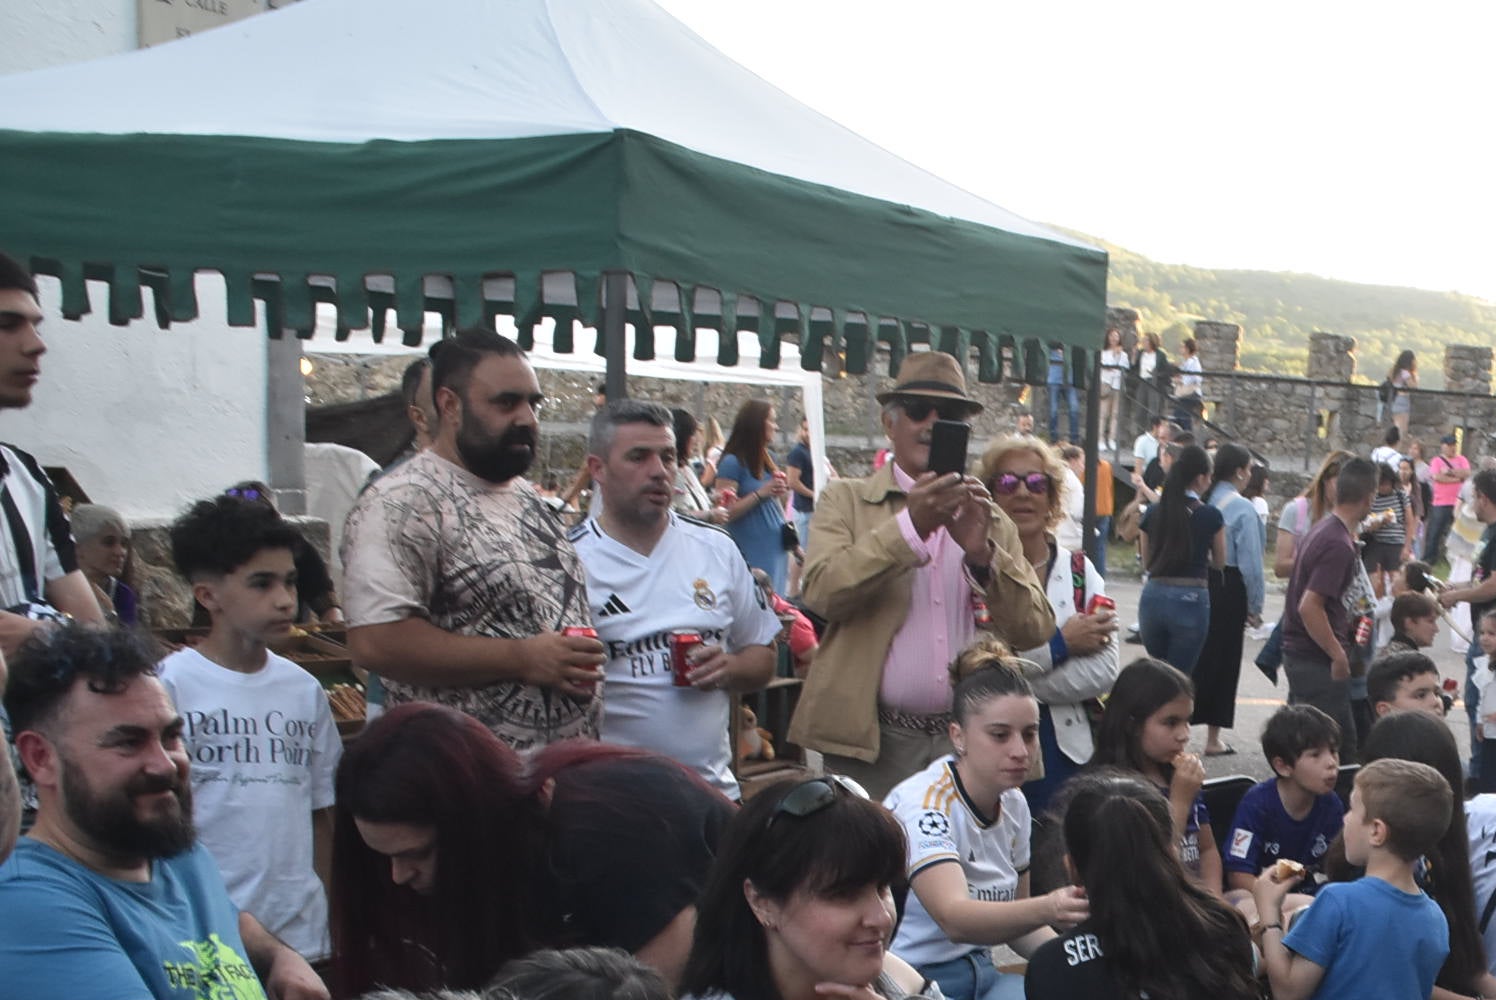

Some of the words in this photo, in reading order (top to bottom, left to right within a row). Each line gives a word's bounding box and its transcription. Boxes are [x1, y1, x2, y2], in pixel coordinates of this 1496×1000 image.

[629, 653, 656, 678] FLY
[184, 707, 259, 737] Palm
[264, 709, 318, 739] Cove
[269, 737, 313, 767] Poin
[1062, 933, 1104, 967] SER
